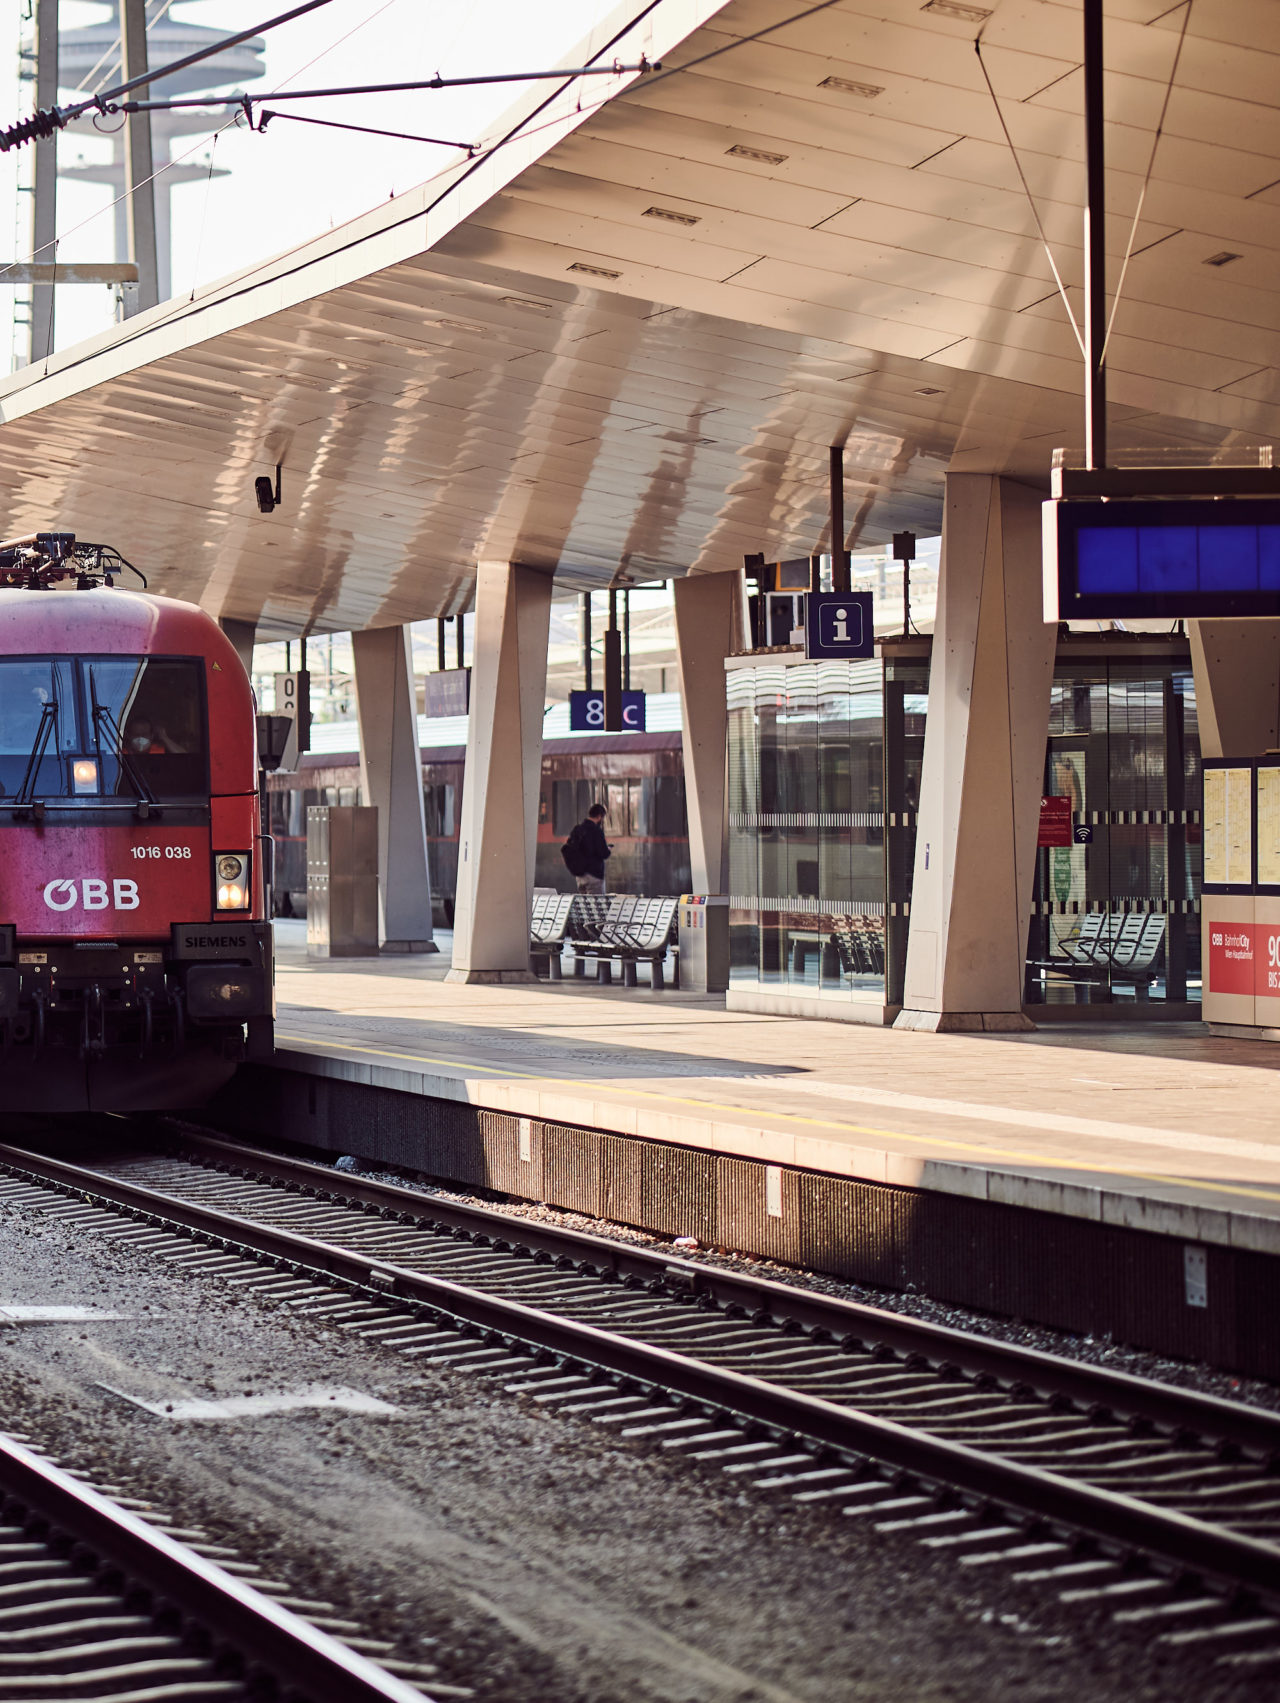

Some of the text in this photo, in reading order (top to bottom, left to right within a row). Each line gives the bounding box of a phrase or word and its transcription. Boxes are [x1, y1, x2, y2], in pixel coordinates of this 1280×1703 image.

[585, 699, 604, 725] 8
[130, 846, 192, 859] 1016 038
[43, 878, 140, 912] ÖBB
[184, 936, 247, 948] SIEMENS
